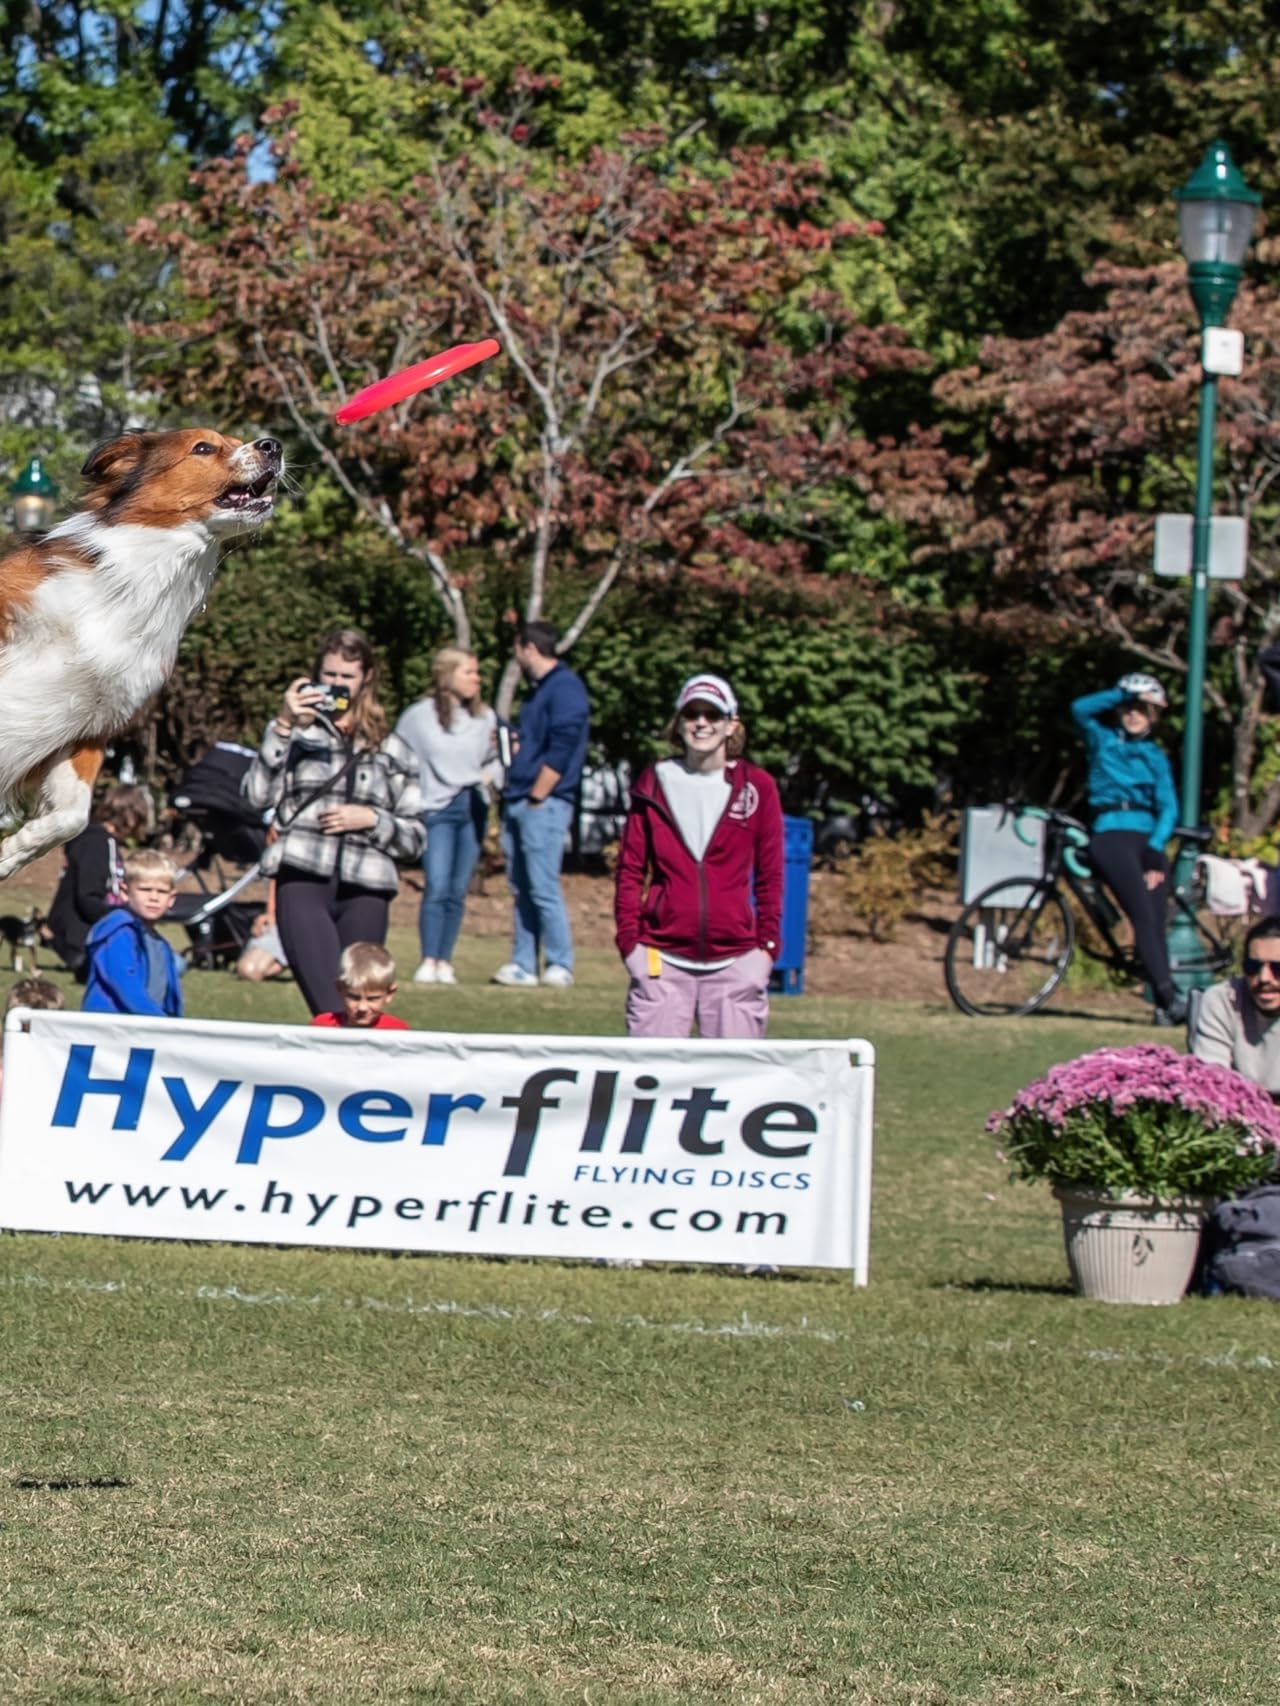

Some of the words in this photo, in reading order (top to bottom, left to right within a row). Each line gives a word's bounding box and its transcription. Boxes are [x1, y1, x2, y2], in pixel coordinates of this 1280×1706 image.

[49, 1042, 819, 1178] Hyperflite
[574, 1165, 695, 1186] FLYING
[710, 1169, 811, 1189] DISCS
[64, 1180, 788, 1236] www.hyperflite.com
